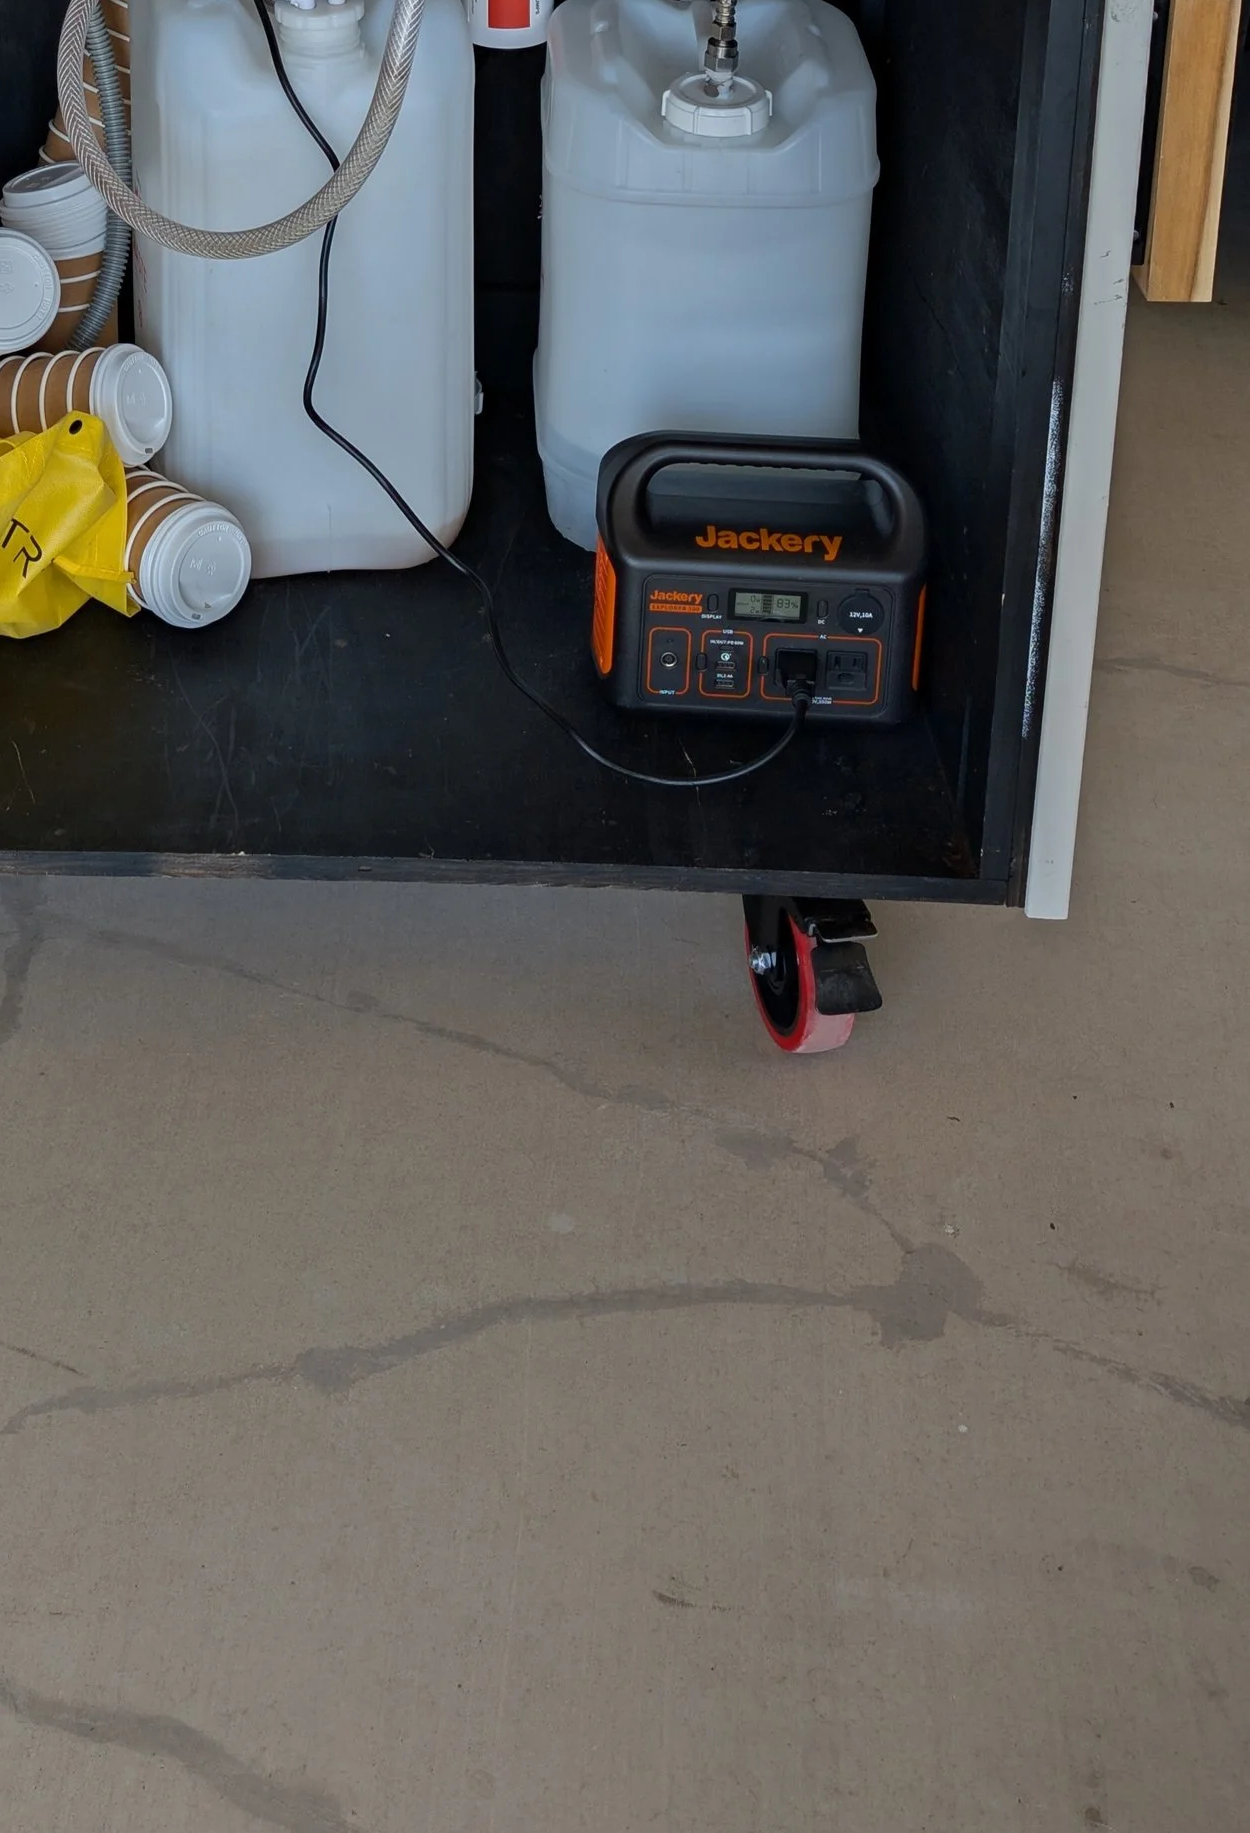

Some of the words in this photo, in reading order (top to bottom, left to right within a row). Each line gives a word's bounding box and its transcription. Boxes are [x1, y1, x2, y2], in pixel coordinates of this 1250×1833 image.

[695, 525, 842, 561] Jackery
[650, 590, 703, 604] Jackery
[776, 599, 798, 609] 83%
